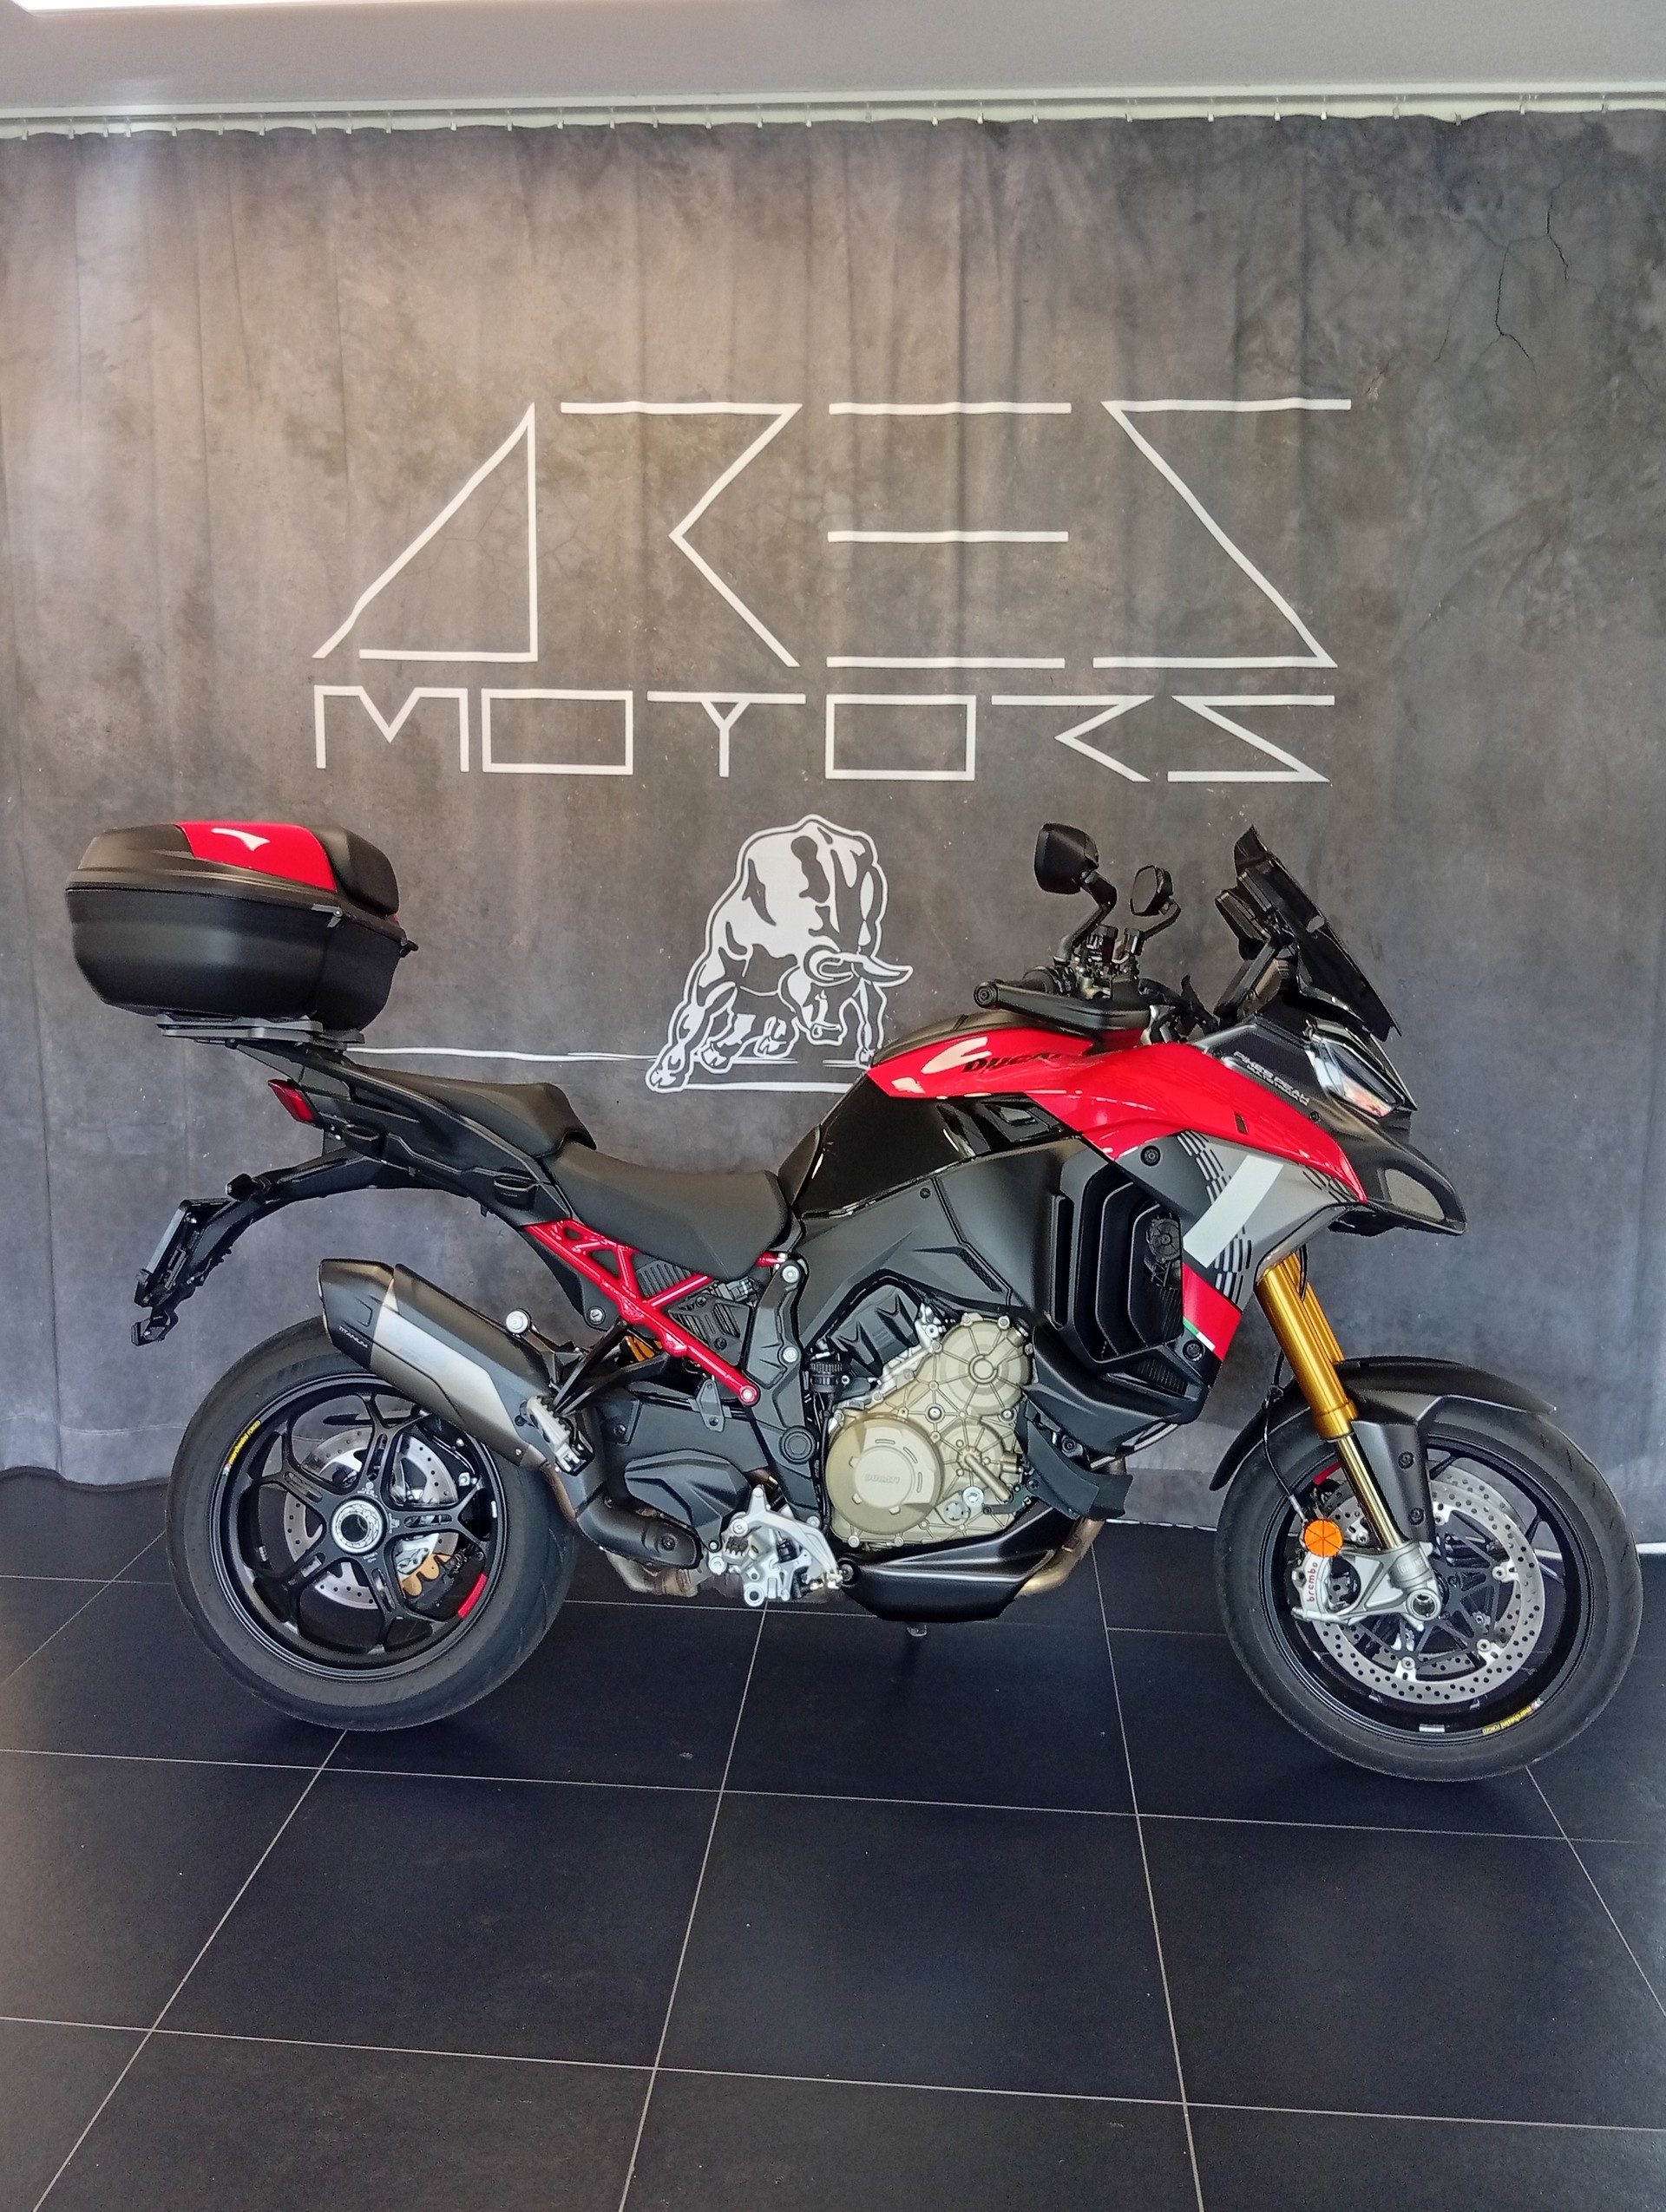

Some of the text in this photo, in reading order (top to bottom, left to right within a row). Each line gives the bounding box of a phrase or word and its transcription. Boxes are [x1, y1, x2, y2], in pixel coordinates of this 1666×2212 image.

[312, 397, 1351, 671] ARES
[314, 684, 1335, 782] MOTORS
[1307, 1562, 1318, 1602] brembo
